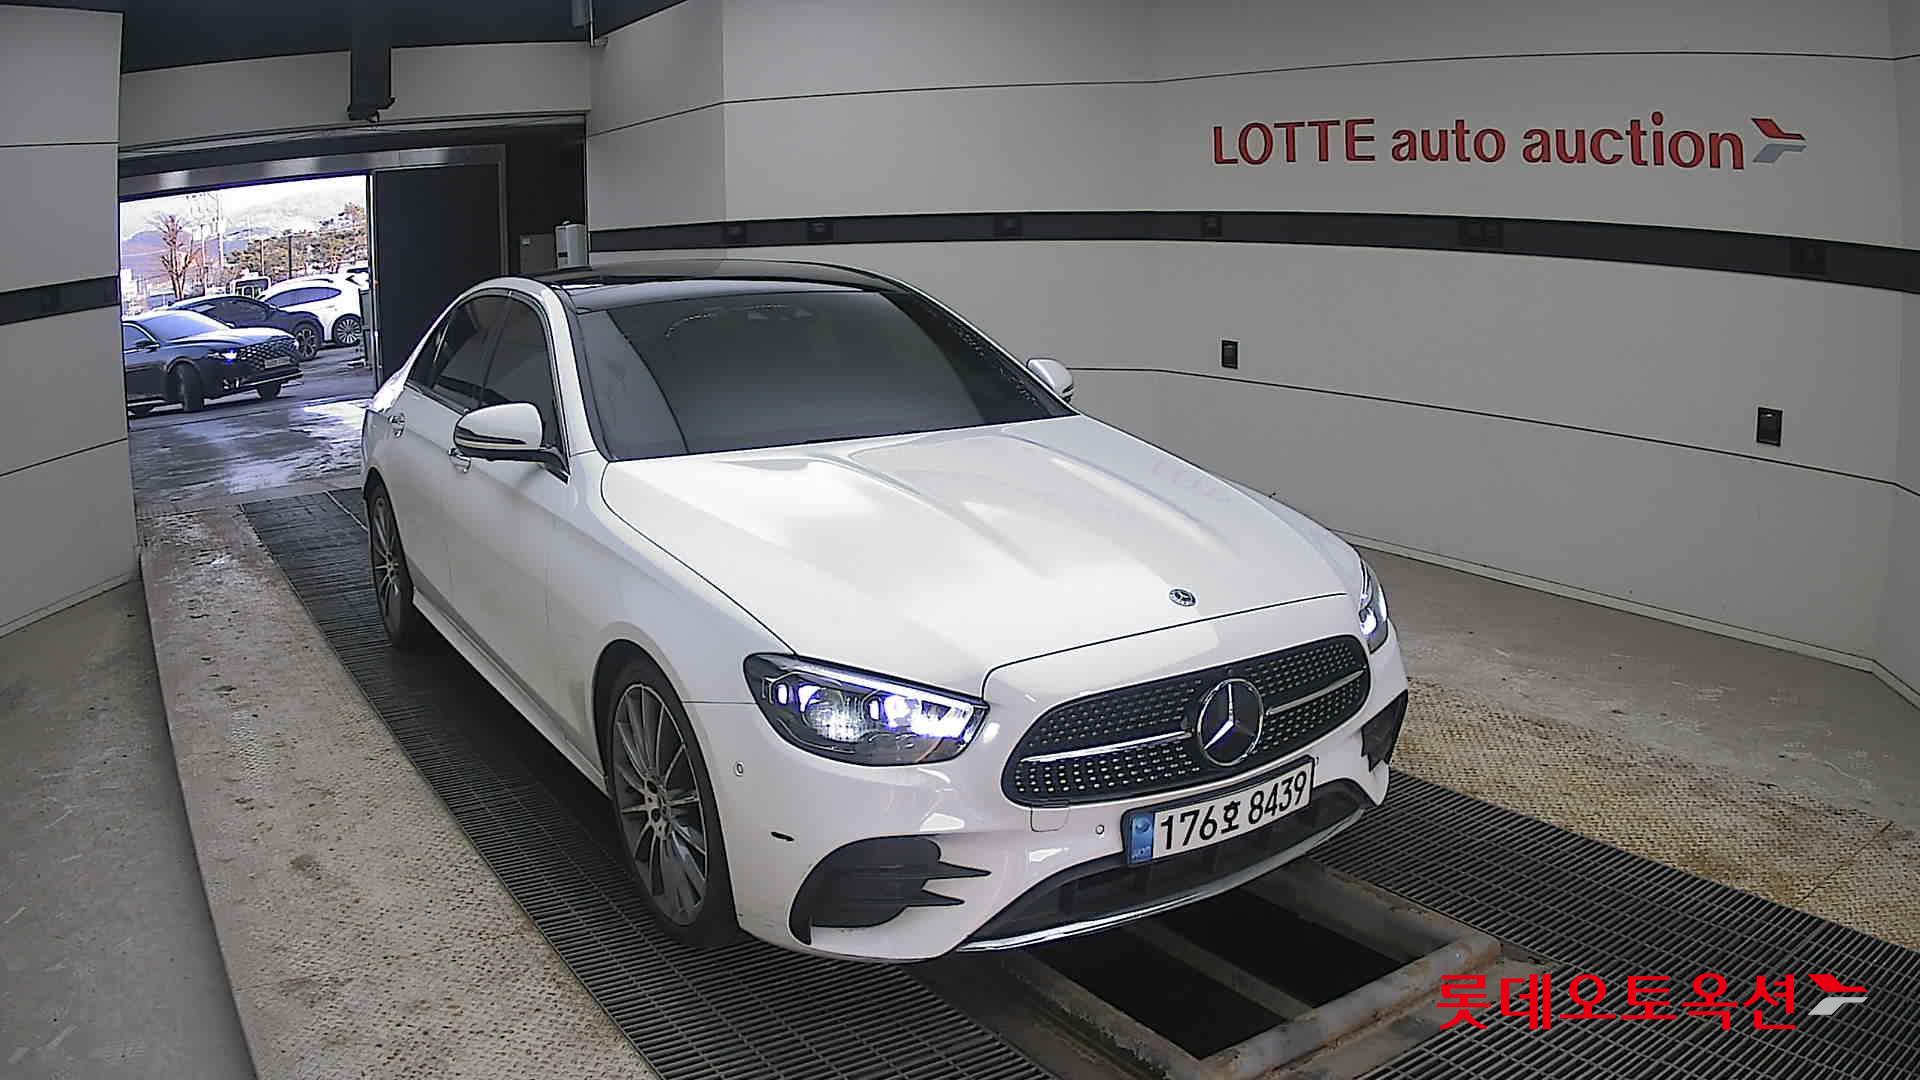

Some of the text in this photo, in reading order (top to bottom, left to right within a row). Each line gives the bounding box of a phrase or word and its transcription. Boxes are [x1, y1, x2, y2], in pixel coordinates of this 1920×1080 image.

[1213, 111, 1744, 170] LOTTE auto auction
[1160, 771, 1307, 850] 176호 8439
